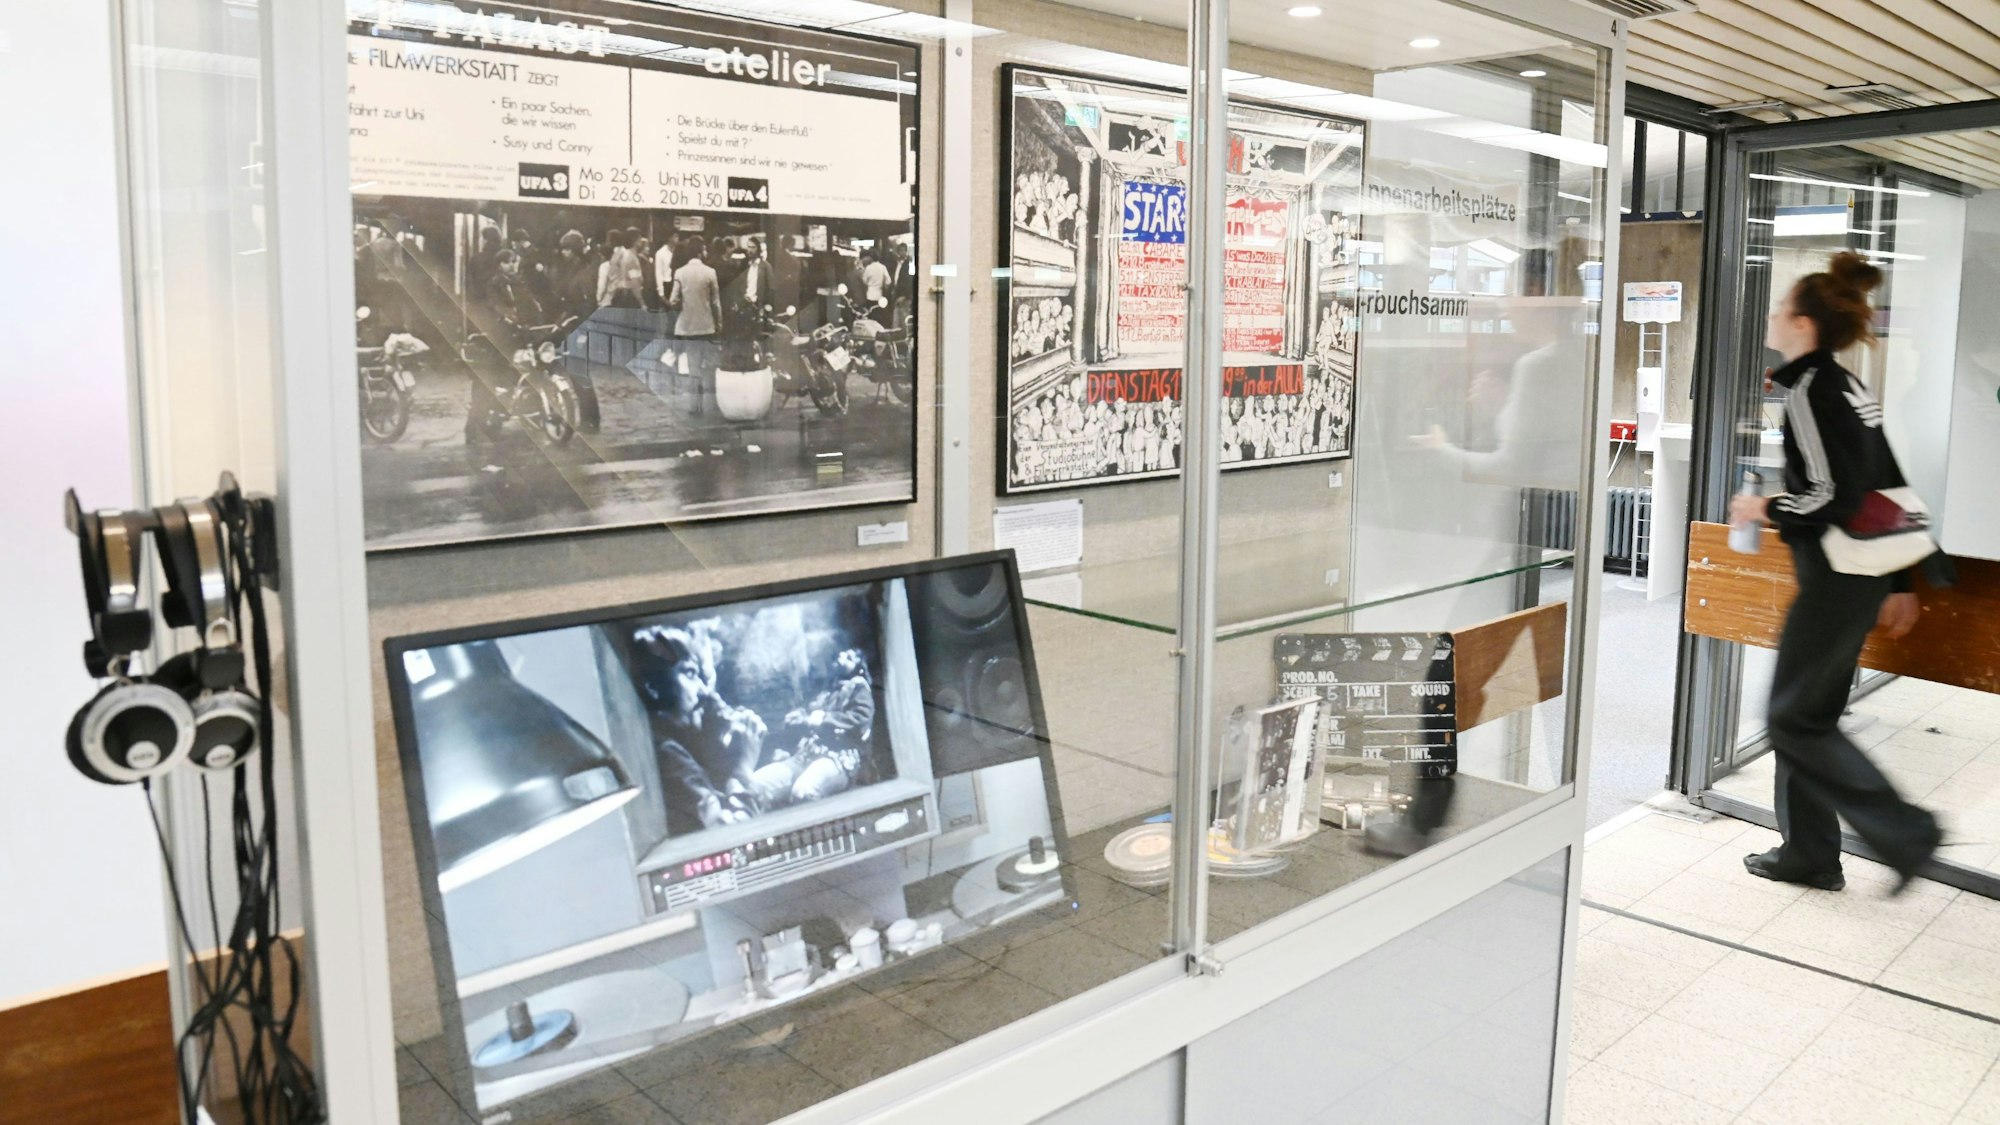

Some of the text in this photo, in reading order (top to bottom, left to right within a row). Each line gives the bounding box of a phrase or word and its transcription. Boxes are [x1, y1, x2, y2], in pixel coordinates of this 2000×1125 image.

[1611, 19, 1617, 37] 4
[369, 48, 520, 82] FILMWERKSTATT
[527, 71, 559, 87] ZEIGT
[704, 46, 832, 86] atelier
[384, 109, 401, 119] zur
[406, 108, 425, 122] Uni
[501, 97, 517, 110] Ein
[522, 103, 546, 116] paar
[502, 114, 577, 131] die wir wissen
[677, 115, 693, 127] Die
[696, 117, 726, 131] Brücke
[729, 119, 749, 133] über
[752, 122, 768, 134] den
[504, 136, 594, 156] Susy und Conny
[678, 132, 707, 147] Spielst
[710, 134, 722, 146] du
[726, 136, 740, 148] mit
[678, 150, 737, 165] Prinzessinnen
[740, 153, 756, 166] sind
[758, 156, 771, 167] wir
[775, 158, 788, 168] nie
[578, 167, 603, 182] Mo
[610, 167, 645, 185] 25.6.
[658, 171, 679, 187] Uni
[683, 173, 701, 188] HS
[579, 185, 596, 200] Di
[610, 186, 645, 203] 26.6.
[1123, 192, 1186, 233] STAR
[1087, 369, 1170, 403] DIENSTAG
[1025, 463, 1032, 476] &
[1352, 685, 1381, 697] TAKE
[1410, 684, 1450, 697] SOUND
[1410, 747, 1432, 760] INT.
